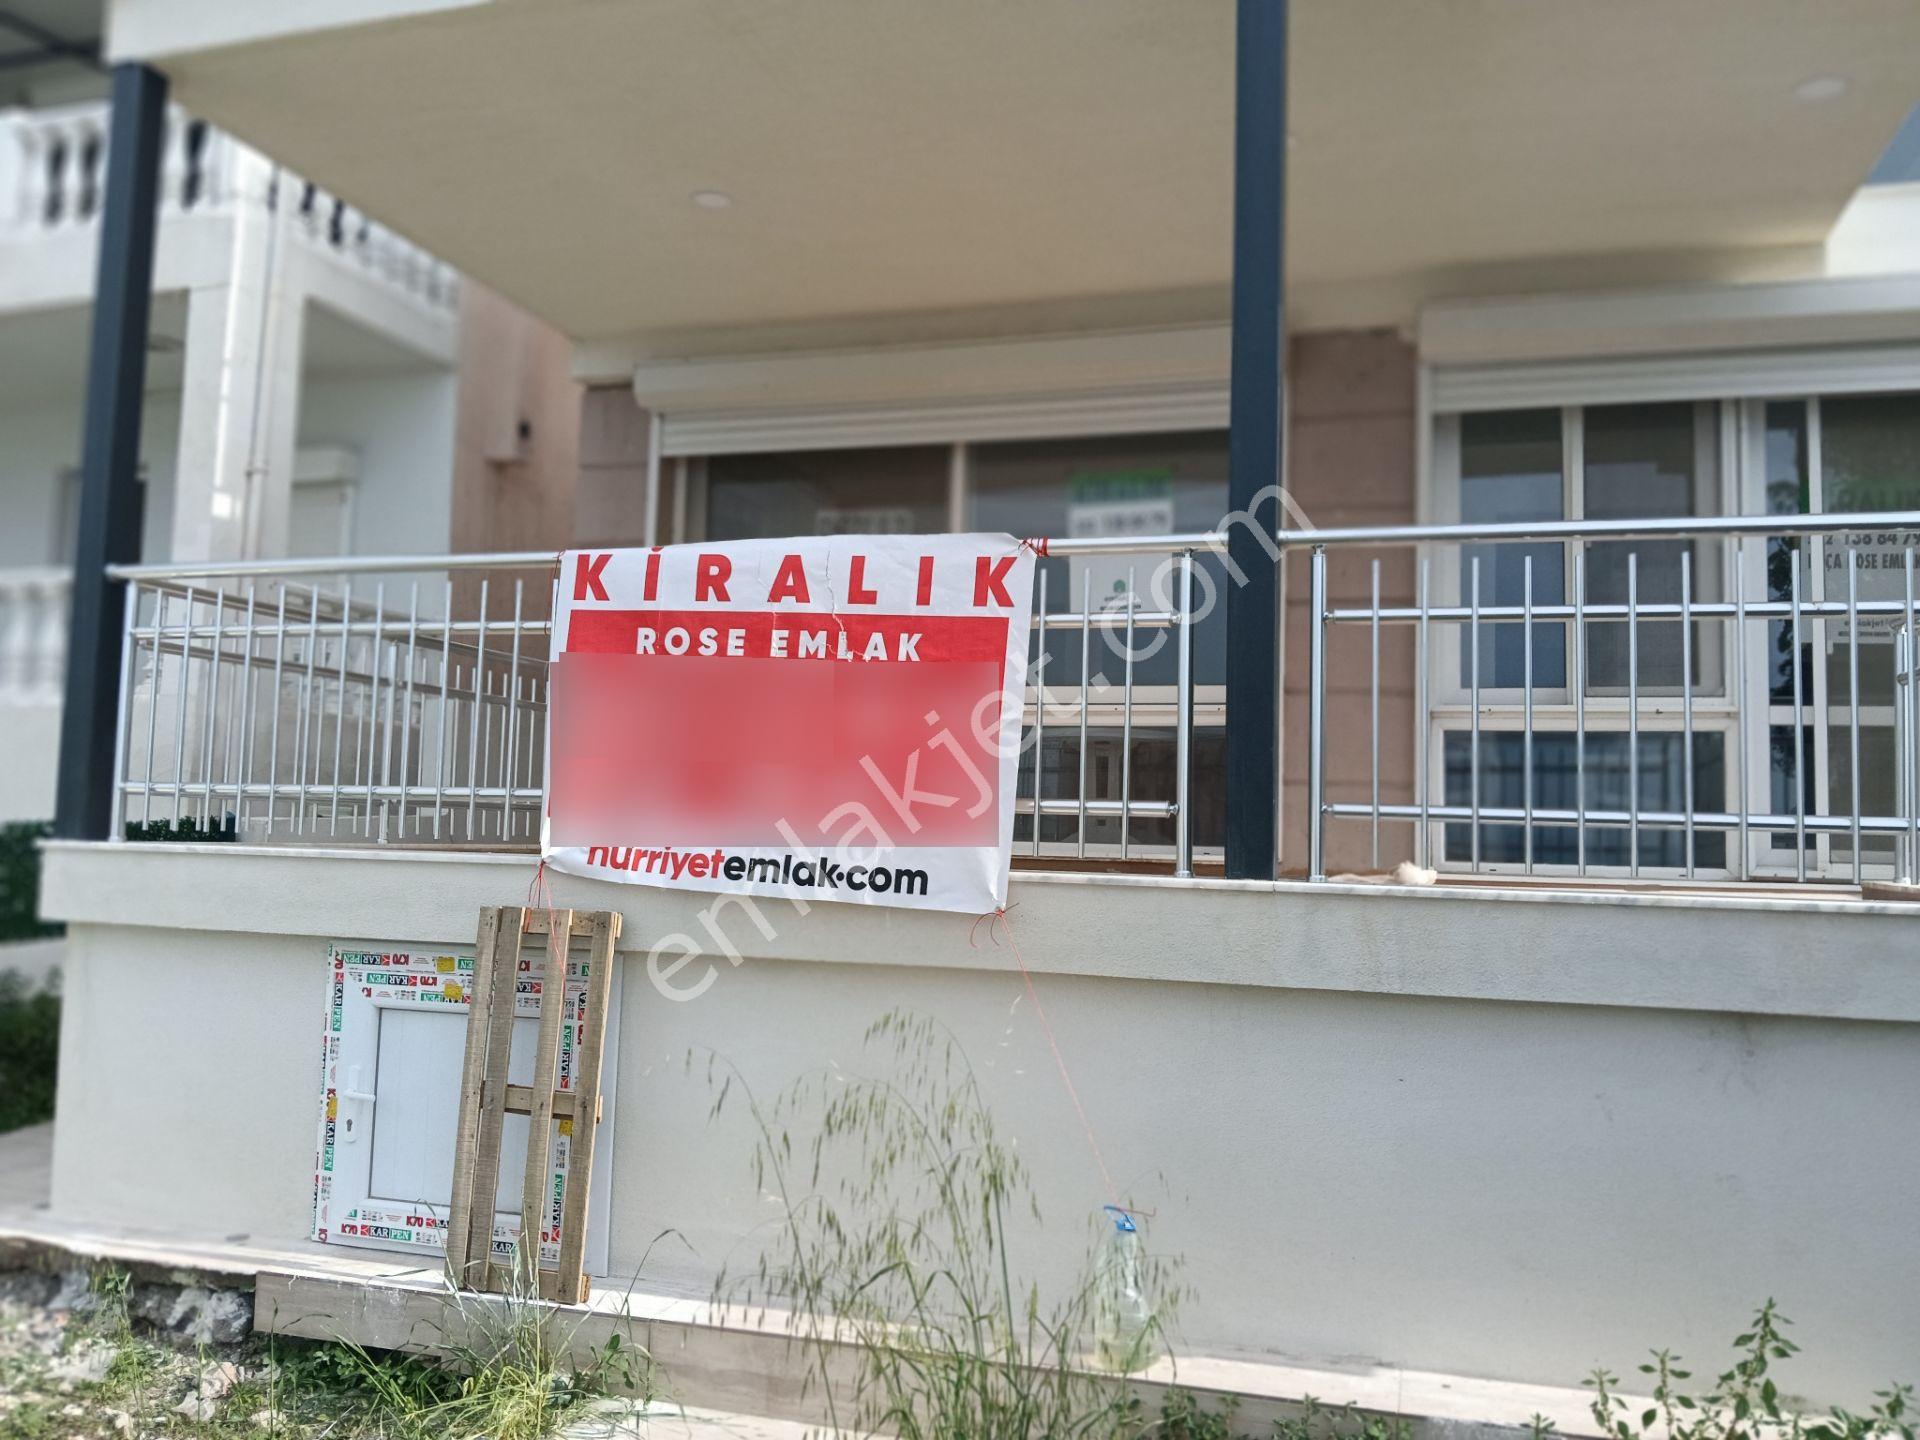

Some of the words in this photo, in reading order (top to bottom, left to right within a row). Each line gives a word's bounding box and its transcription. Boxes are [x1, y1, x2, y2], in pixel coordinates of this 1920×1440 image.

[573, 547, 1018, 608] KİRALIK
[636, 626, 746, 657] ROSE
[769, 628, 923, 662] EMLAK
